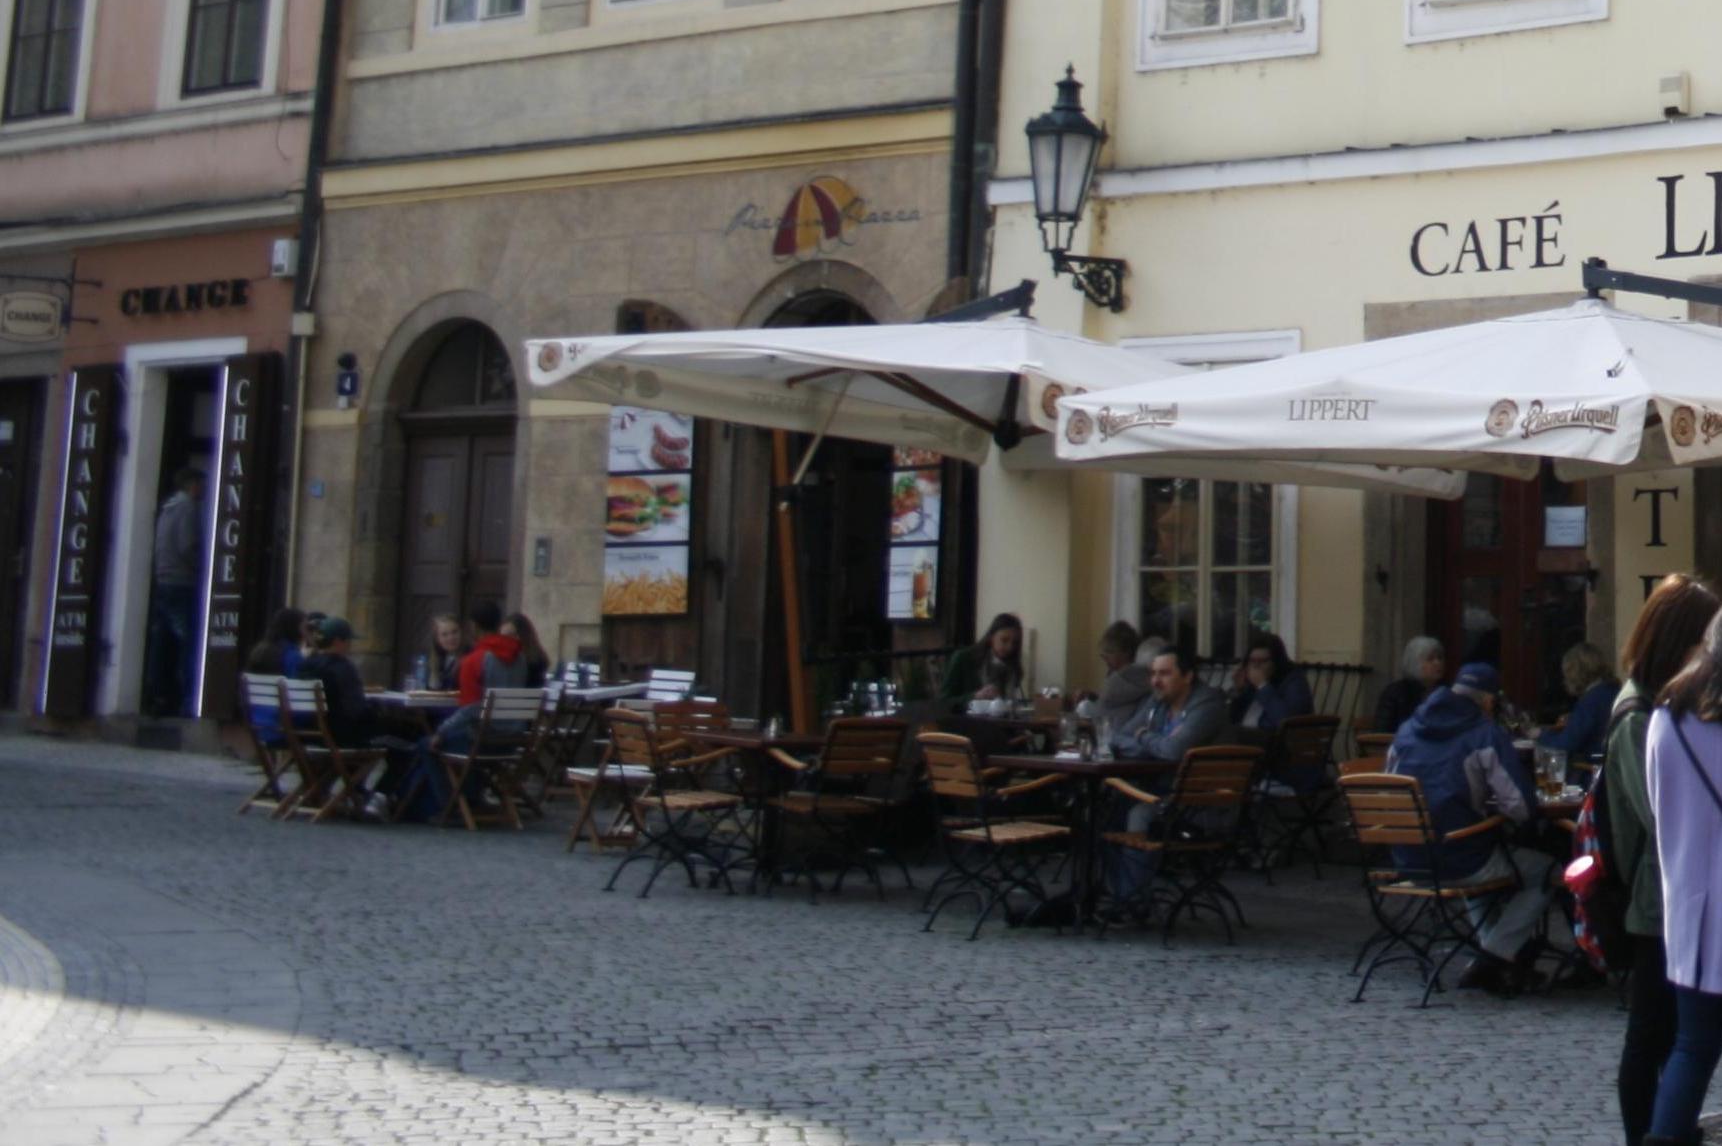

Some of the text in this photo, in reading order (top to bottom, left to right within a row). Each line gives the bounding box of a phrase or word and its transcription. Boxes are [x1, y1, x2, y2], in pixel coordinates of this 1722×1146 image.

[1410, 200, 1566, 276] CAFÉ
[121, 279, 250, 317] CHANGE
[1289, 399, 1374, 421] LIPPERT
[1521, 400, 1619, 439] Pilsner Urquell
[67, 388, 99, 584] CHANGE
[221, 378, 250, 583] CHANGE
